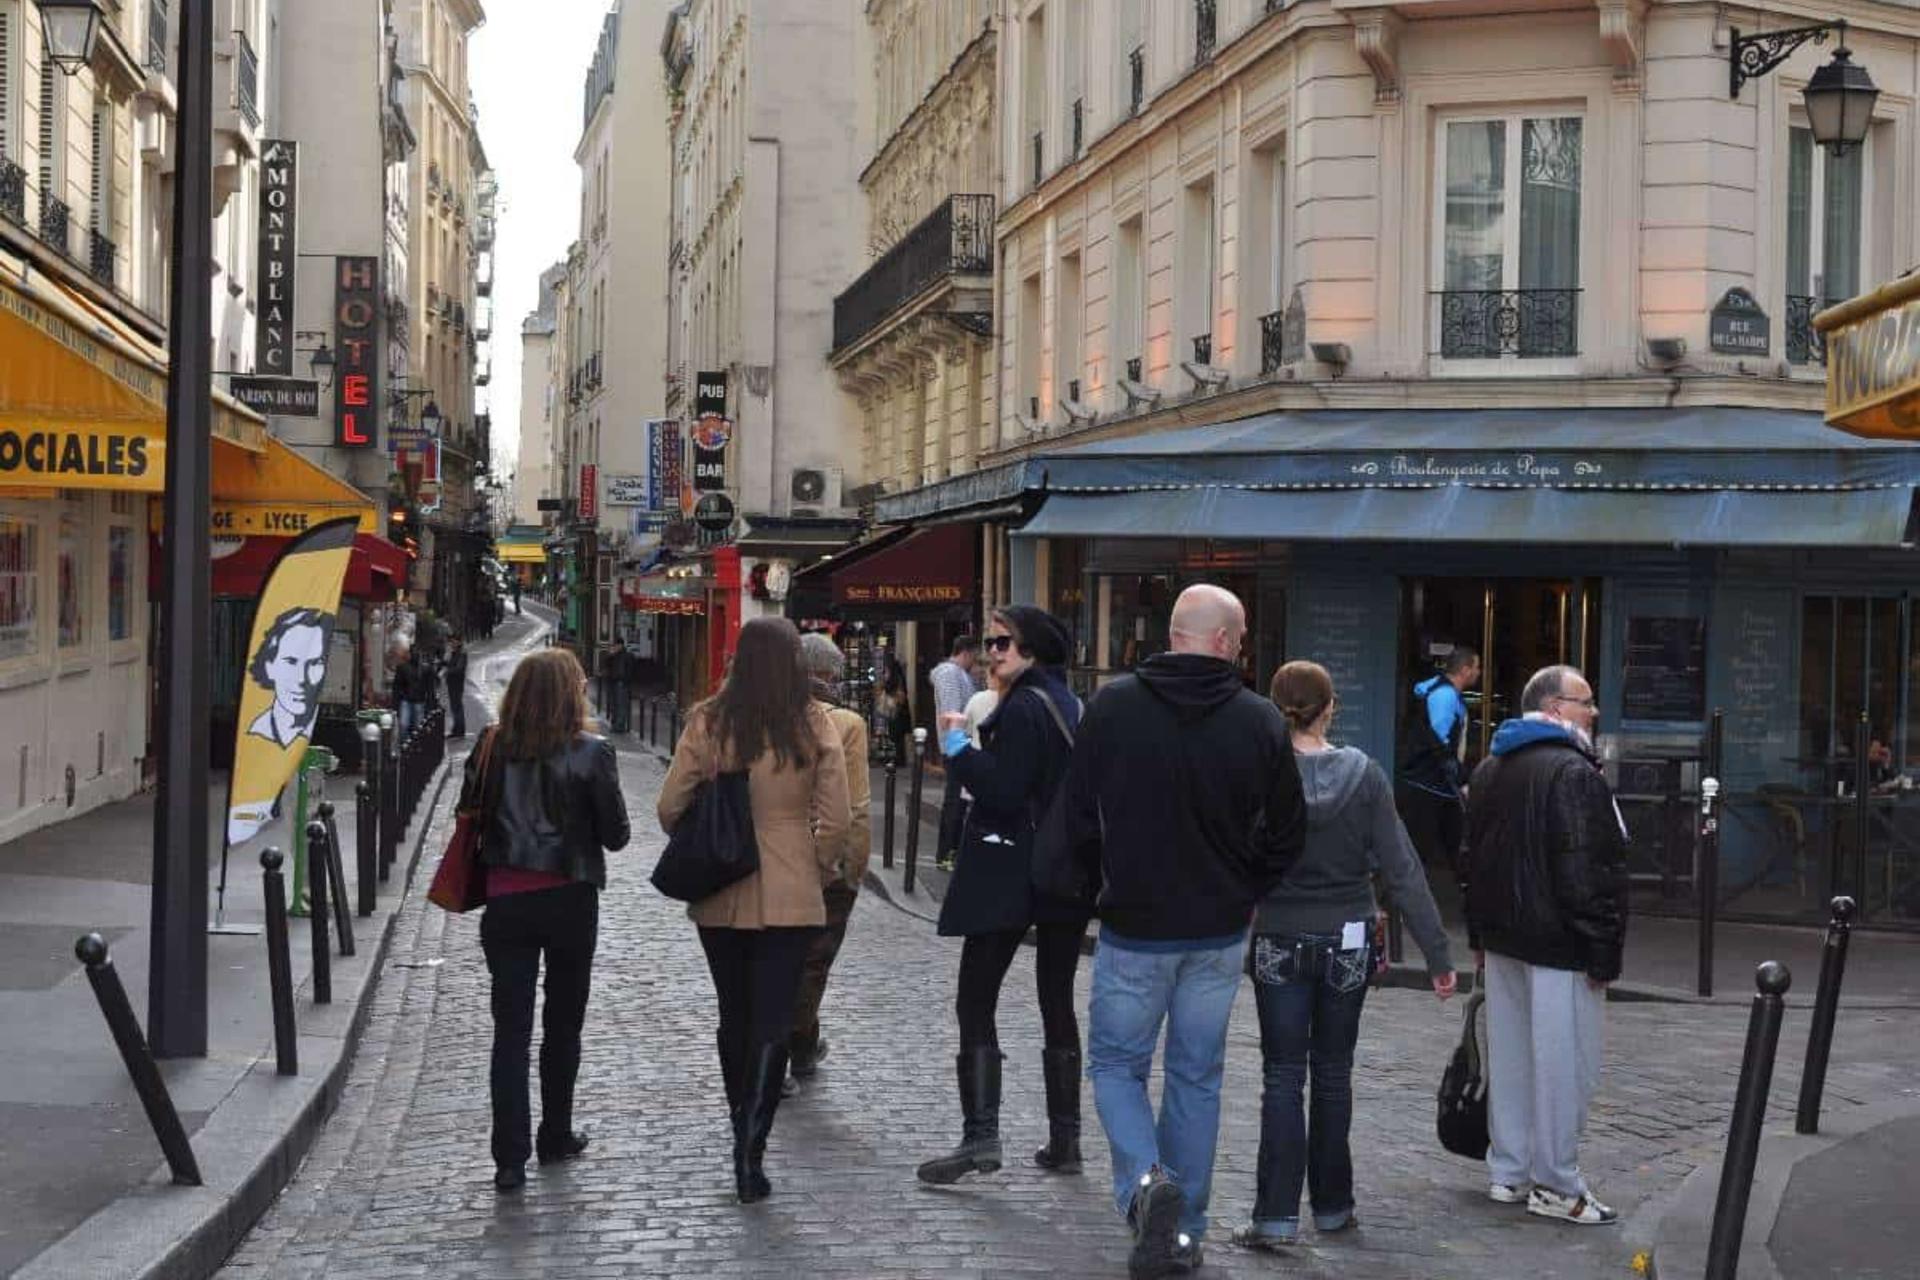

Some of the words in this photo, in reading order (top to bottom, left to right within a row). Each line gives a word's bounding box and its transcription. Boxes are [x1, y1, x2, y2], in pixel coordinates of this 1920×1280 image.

[267, 168, 288, 251] MONT
[266, 261, 284, 367] BLANC
[341, 260, 373, 443] HOTEL
[699, 384, 725, 398] PUB
[696, 464, 723, 477] BAR
[1391, 455, 1487, 480] Boulangerie
[1491, 461, 1510, 475] de
[1517, 454, 1559, 480] Papa
[878, 585, 961, 602] FRANÇAISES
